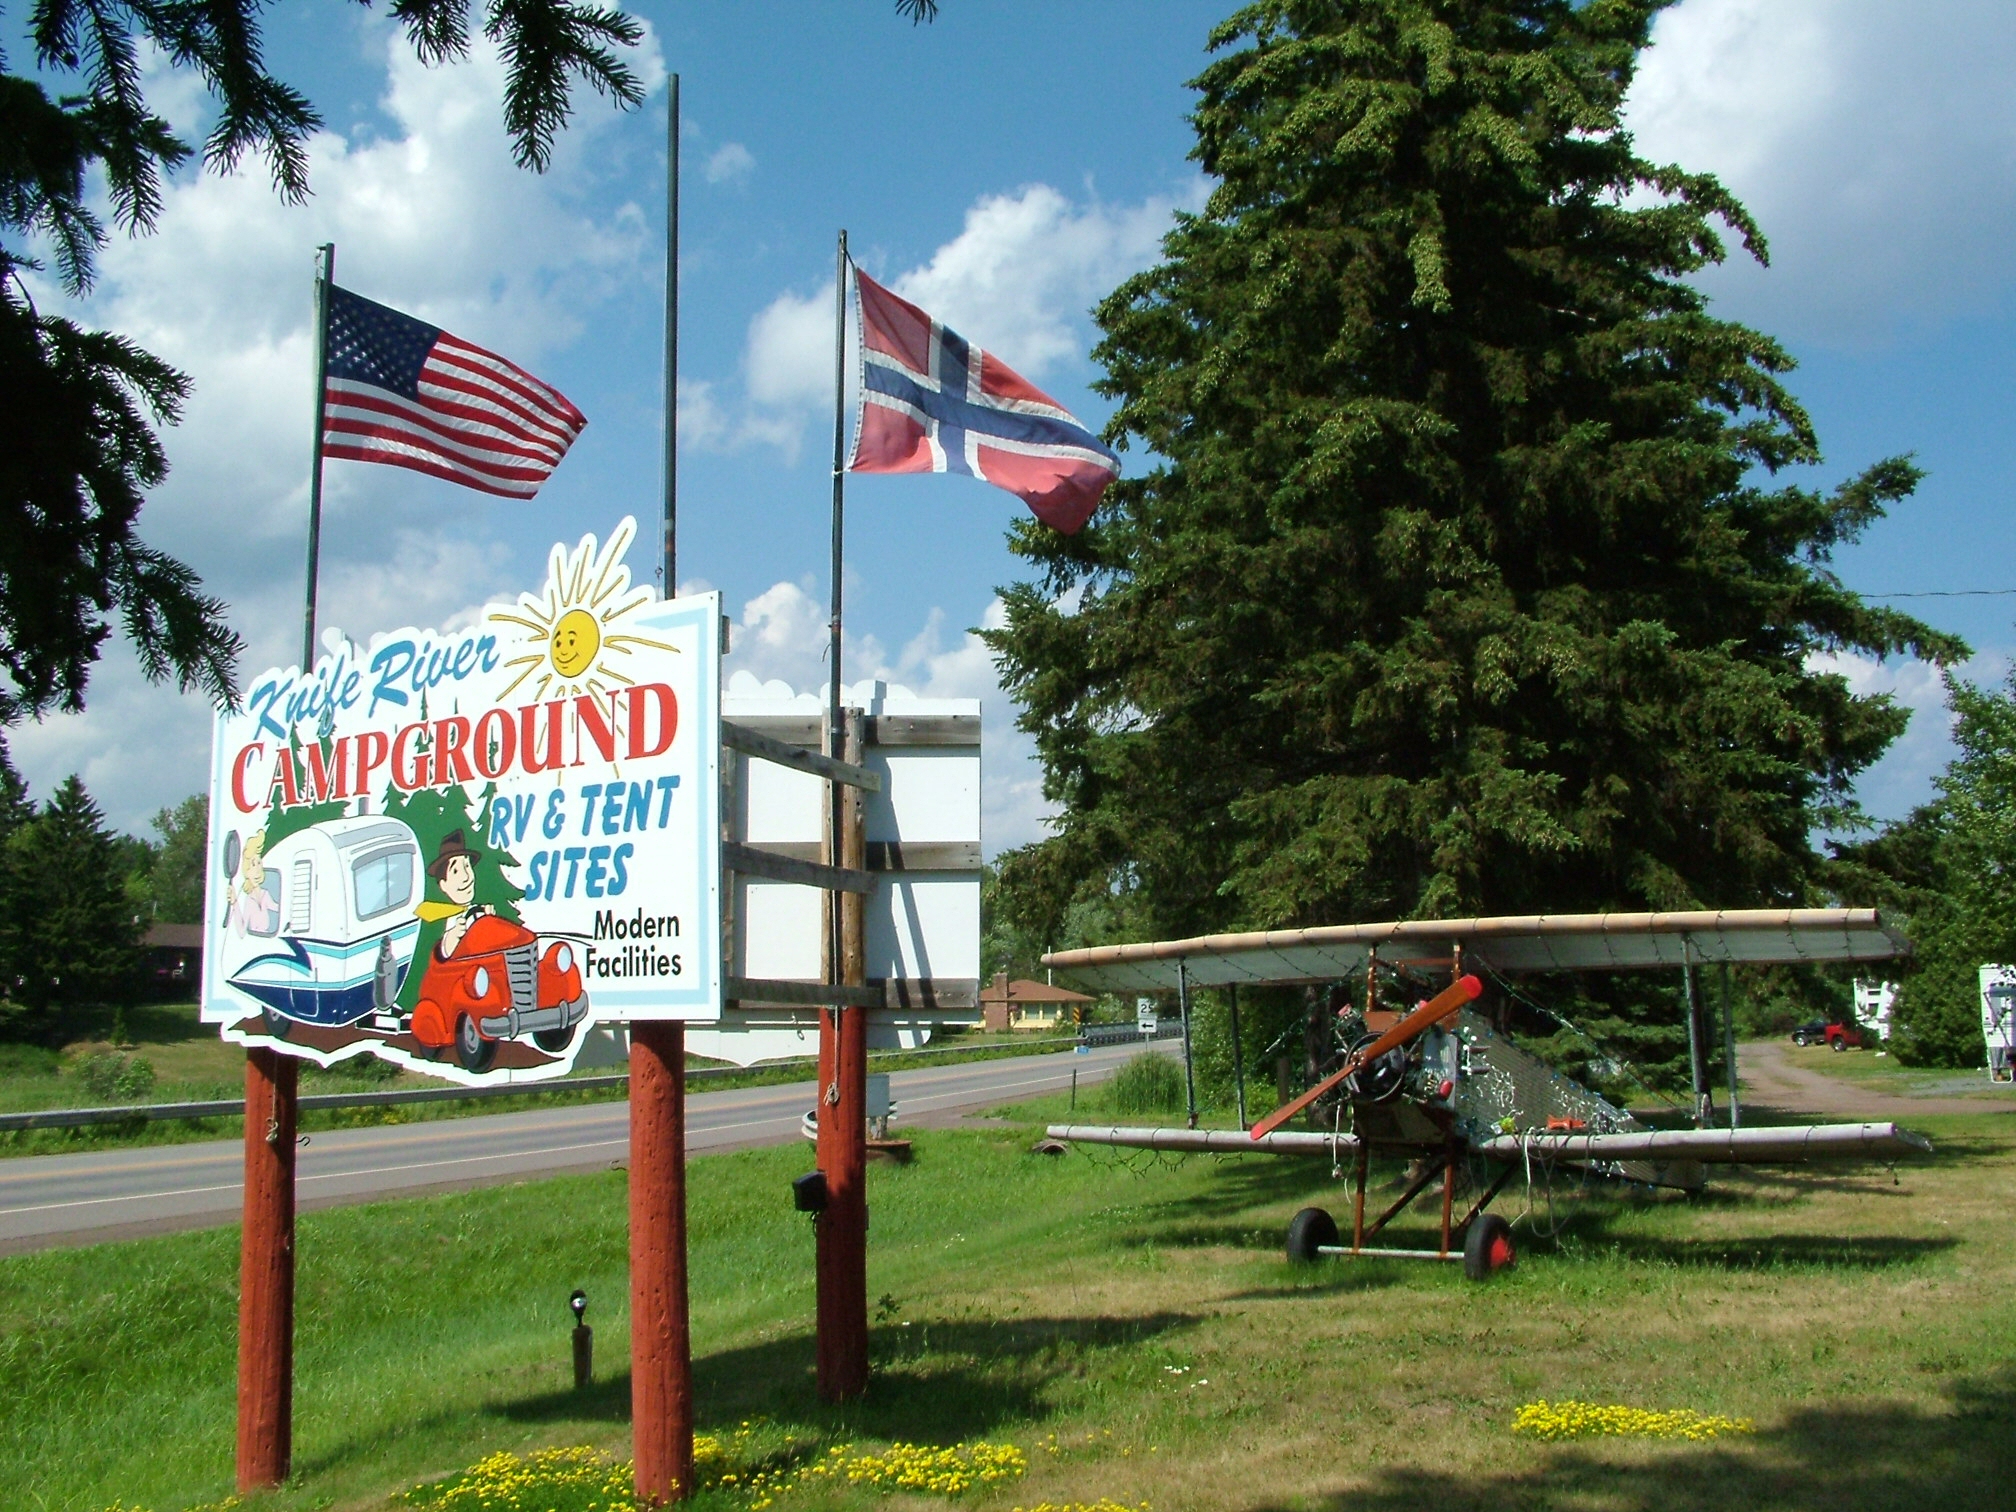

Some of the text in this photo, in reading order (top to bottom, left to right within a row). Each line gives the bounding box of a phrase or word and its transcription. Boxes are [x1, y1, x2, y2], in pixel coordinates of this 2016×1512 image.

[249, 632, 500, 740] Knife River
[231, 682, 680, 813] CAMPGROUND
[491, 776, 681, 848] RV & TENT
[524, 842, 634, 902] SITES
[594, 907, 680, 940] Modern
[585, 944, 682, 978] Facilities
